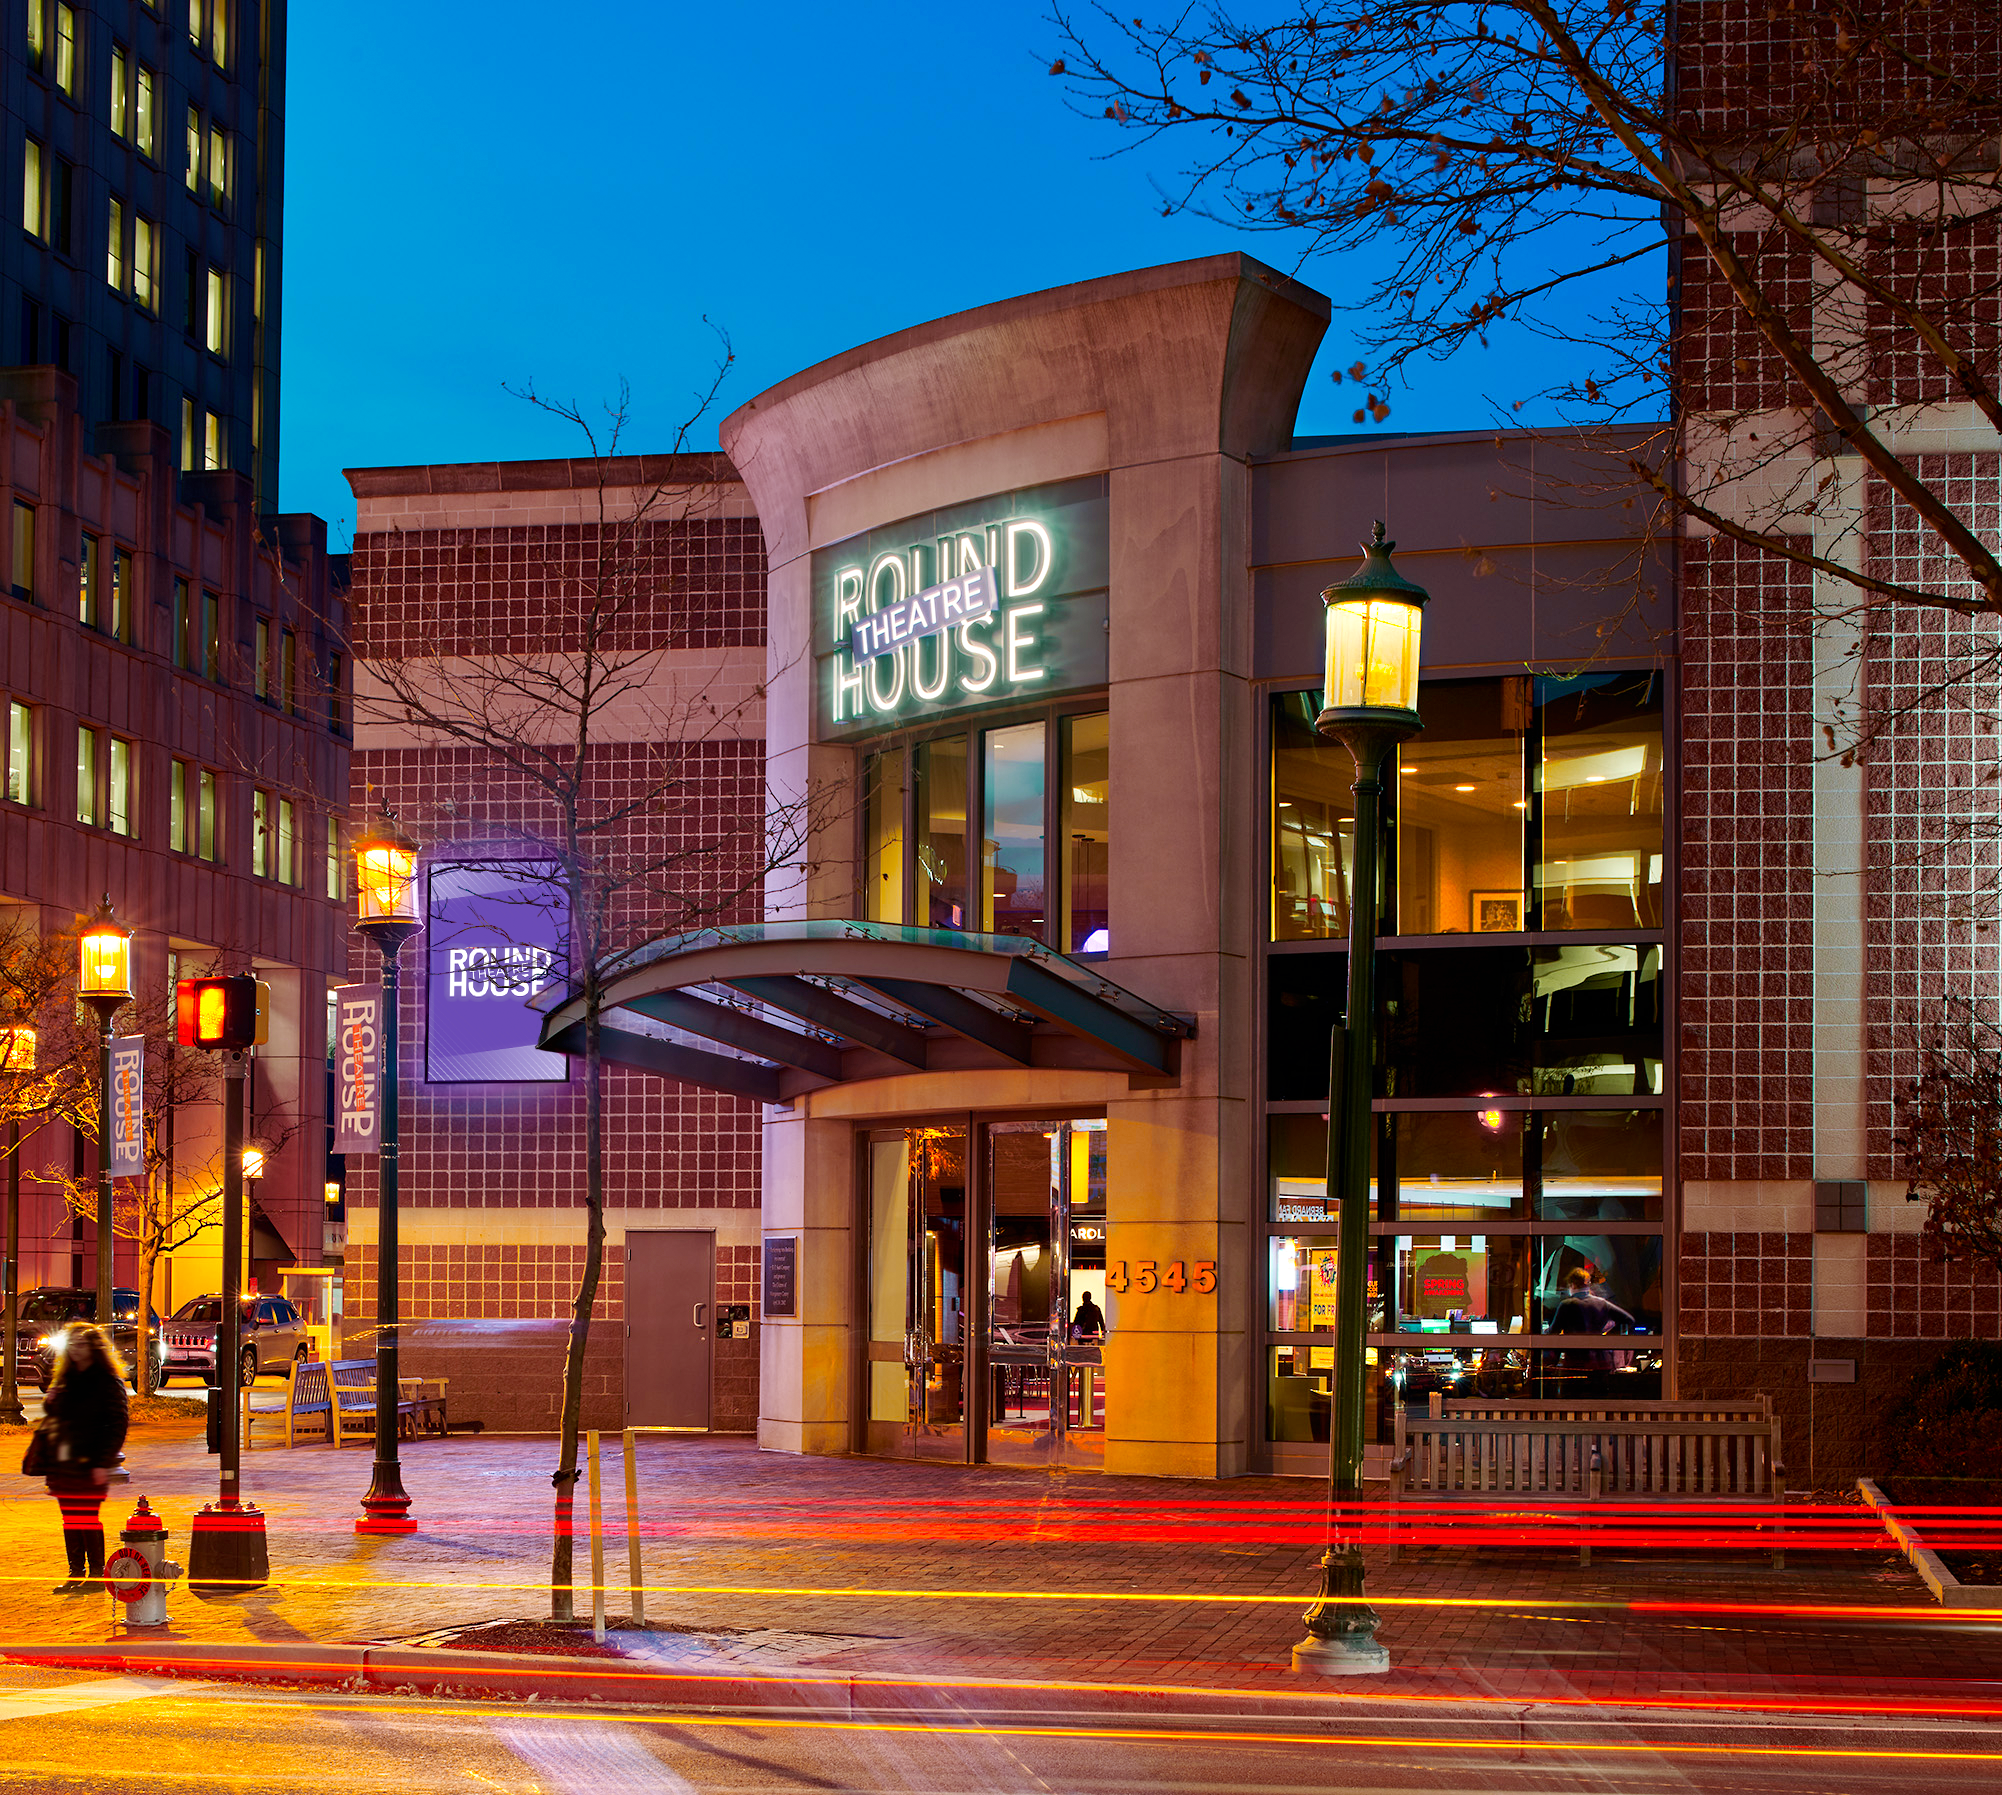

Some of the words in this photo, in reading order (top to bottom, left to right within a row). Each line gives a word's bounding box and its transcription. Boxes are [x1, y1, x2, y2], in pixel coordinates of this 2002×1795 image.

[834, 518, 1051, 646] ROUND
[856, 574, 984, 655] THEATRE
[833, 603, 1044, 724] HOUSE
[449, 947, 552, 974] ROUND
[449, 970, 545, 997] HOUSE
[469, 963, 530, 979] THEATRE
[341, 1002, 358, 1134] HOUSE
[353, 1031, 365, 1108] THEATRE
[357, 1000, 376, 1136] ROUND
[114, 1053, 127, 1161] HOUSE
[123, 1073, 133, 1139] THEATRE
[124, 1049, 140, 1162] ROUND
[1105, 1261, 1217, 1293] 4545
[1313, 1304, 1325, 1315] FOR
[1424, 1279, 1464, 1289] SPRING
[119, 1549, 132, 1558] OUT
[134, 1552, 144, 1562] OF
